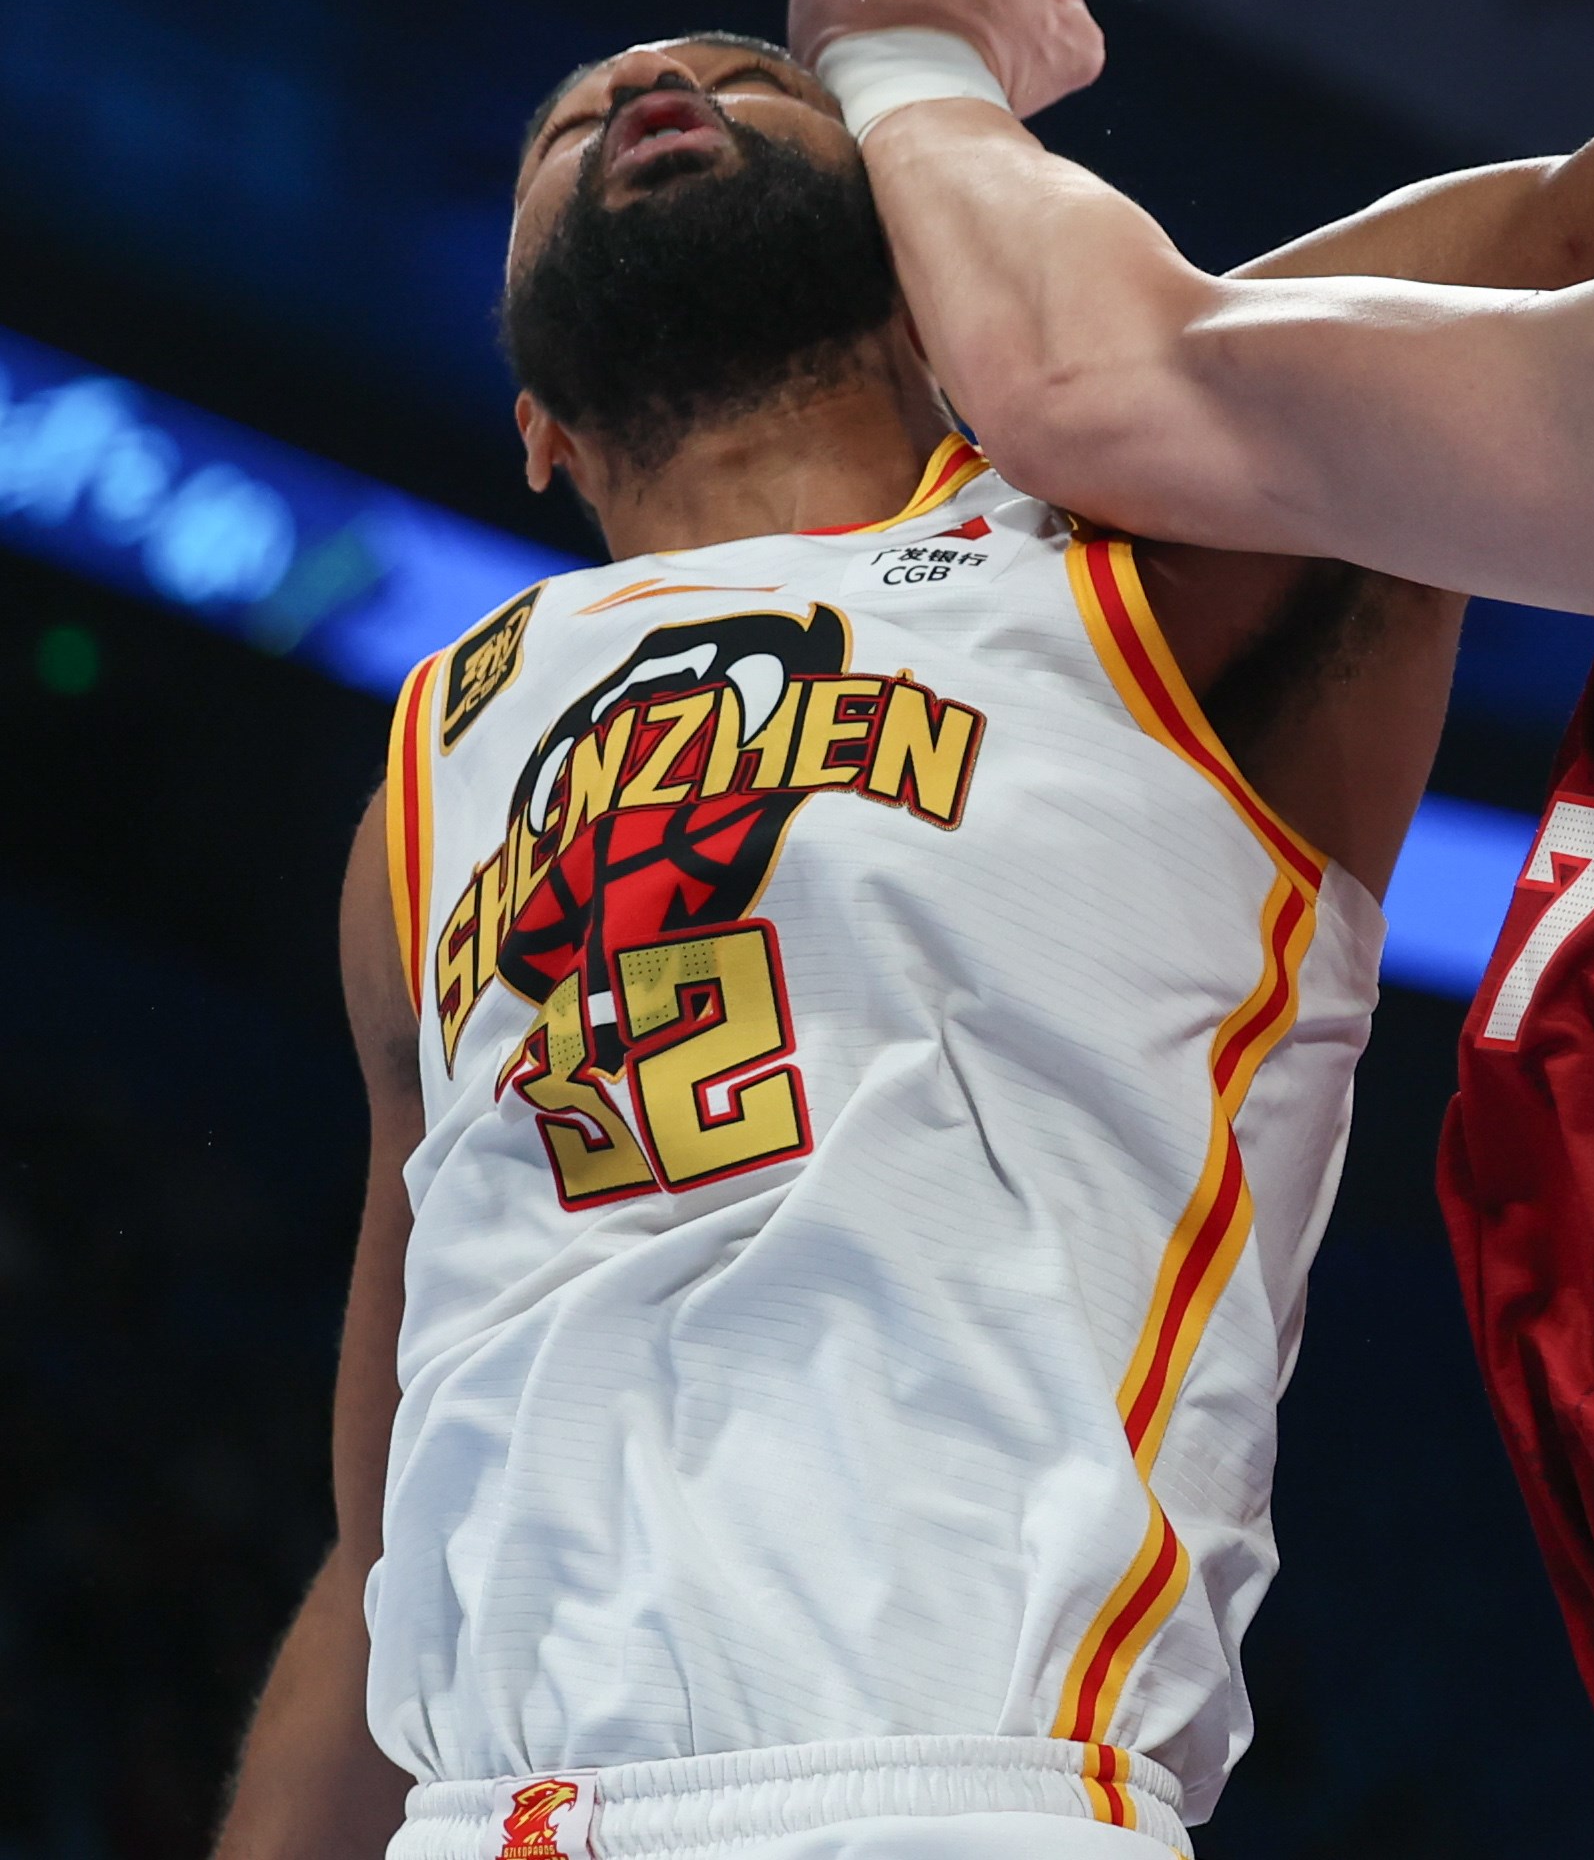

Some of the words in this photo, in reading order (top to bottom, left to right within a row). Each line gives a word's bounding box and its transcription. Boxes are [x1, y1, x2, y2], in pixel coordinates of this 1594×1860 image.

[871, 548, 988, 567] 广发银行
[883, 565, 951, 586] CGB
[435, 671, 987, 1082] SHENZHEN
